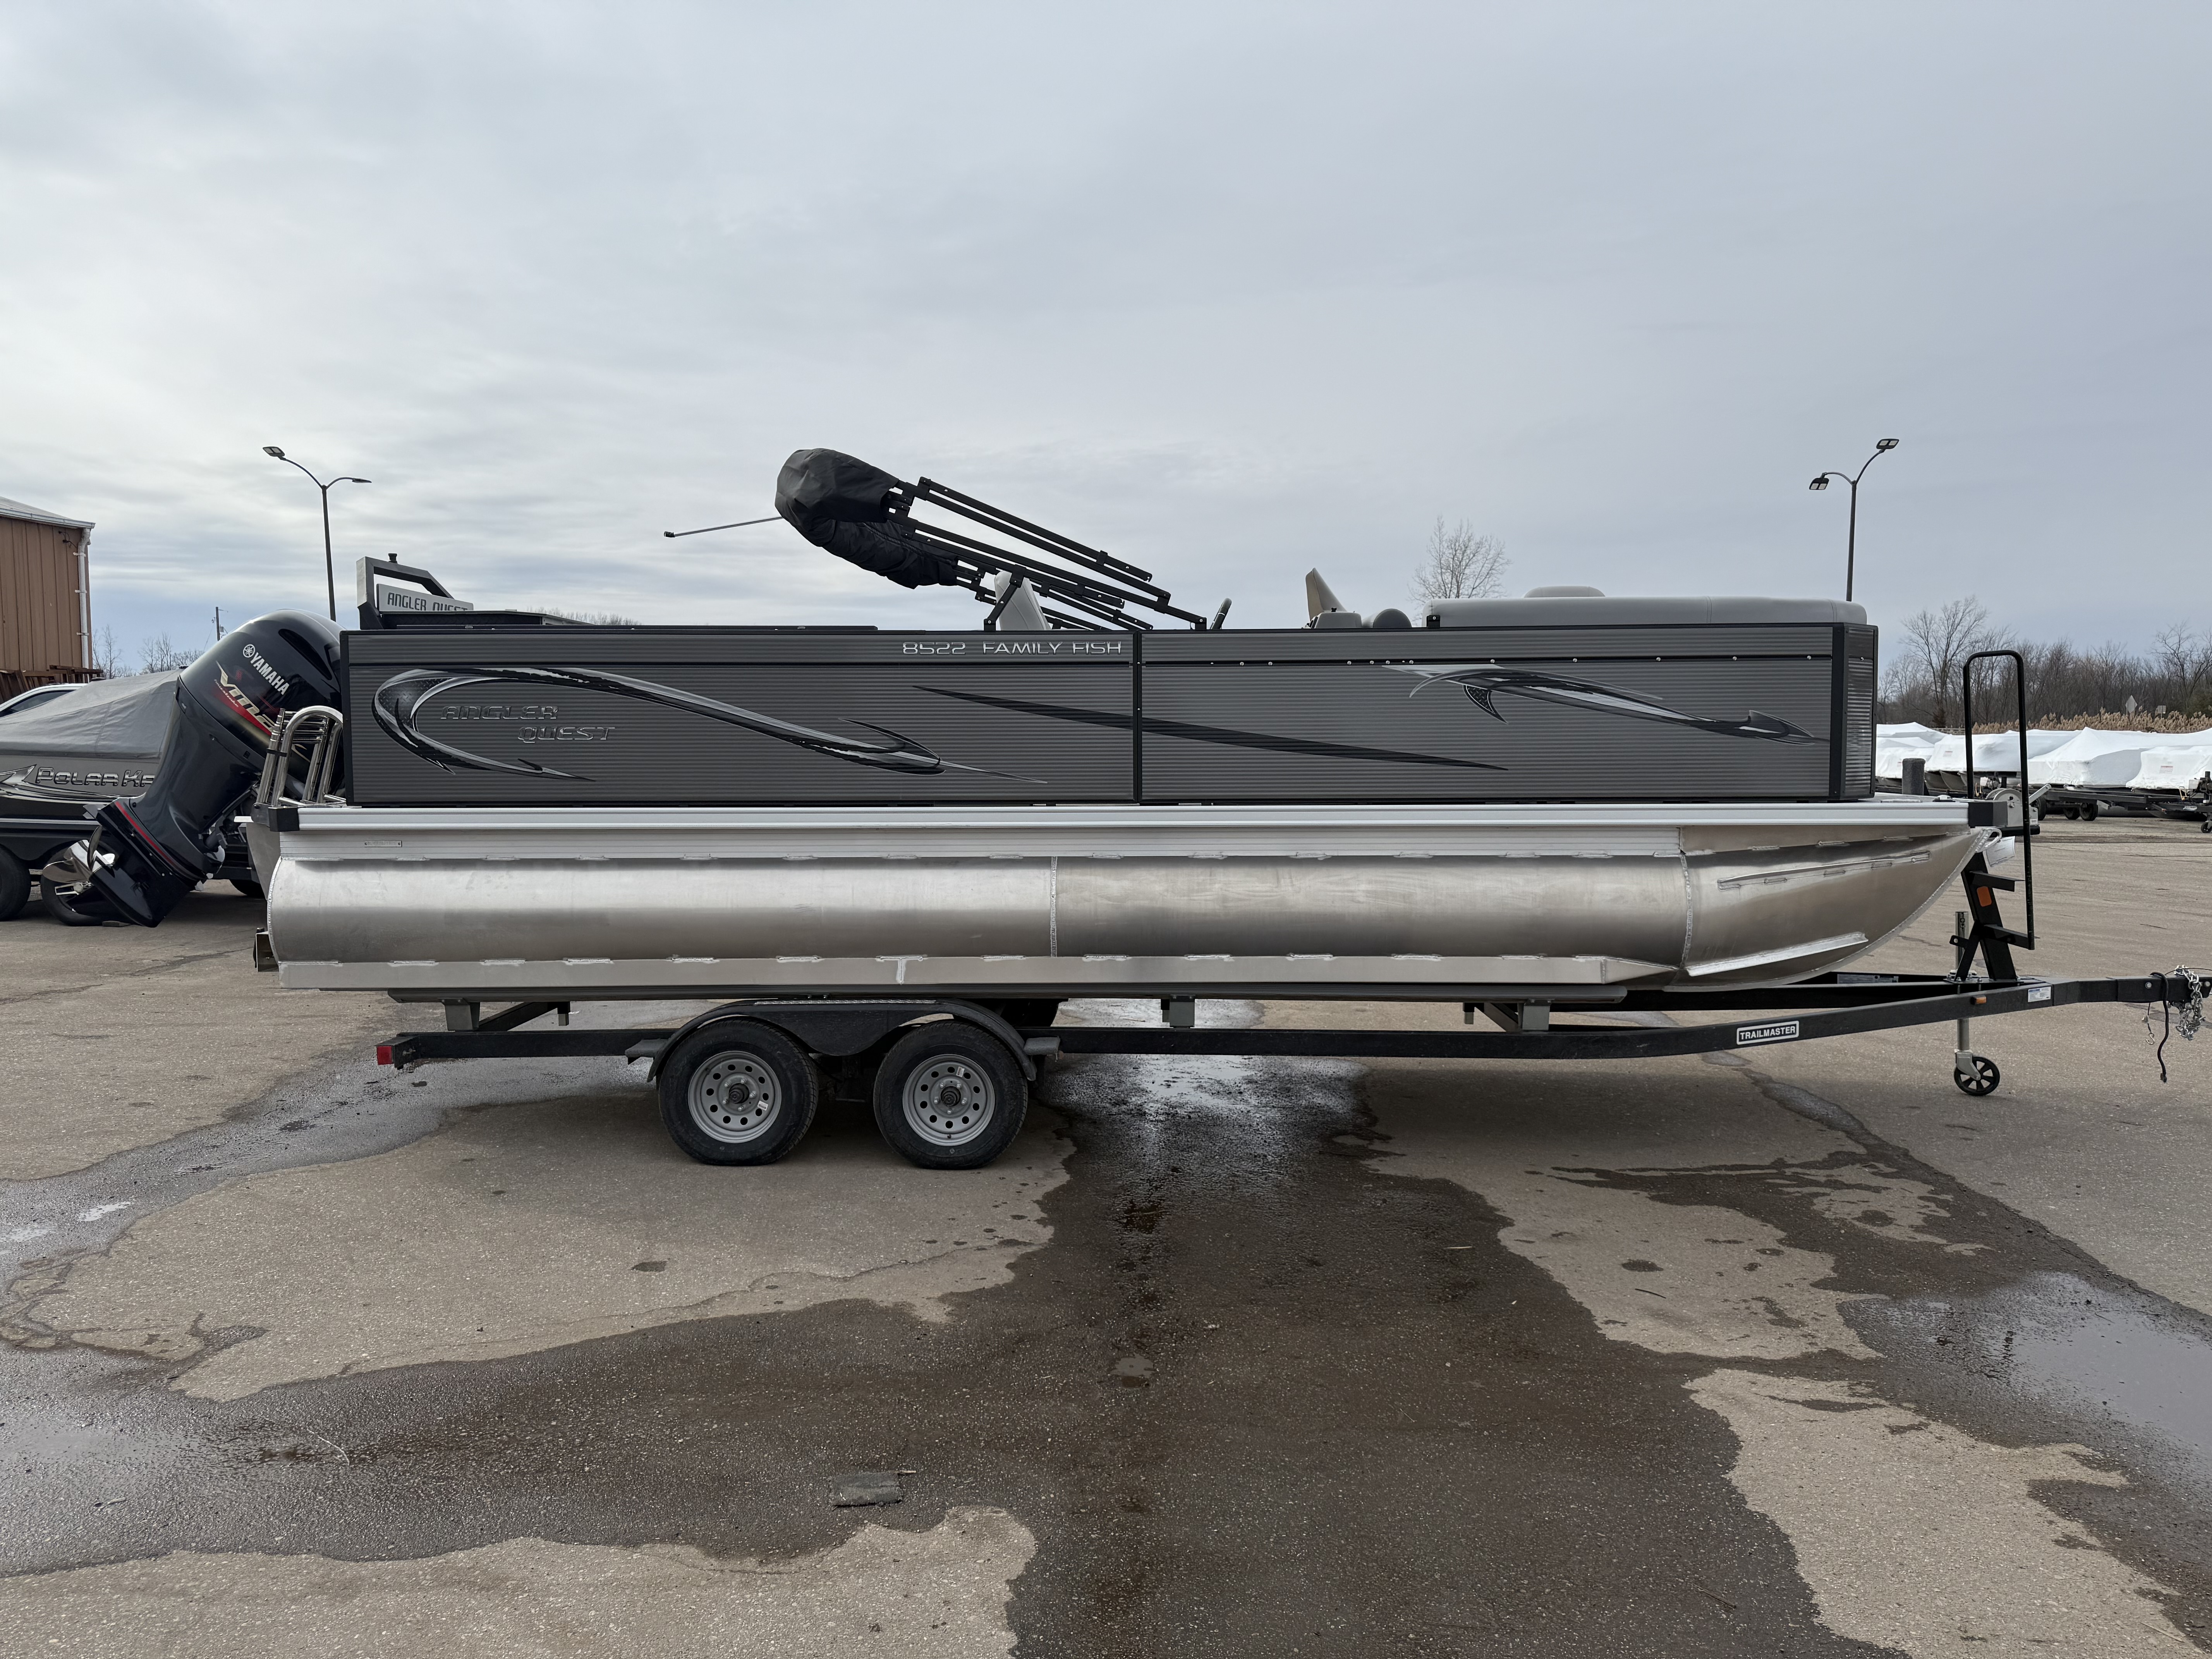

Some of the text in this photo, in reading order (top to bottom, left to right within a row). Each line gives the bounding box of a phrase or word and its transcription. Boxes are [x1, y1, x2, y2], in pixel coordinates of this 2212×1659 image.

[387, 592, 468, 611] ANGLER QUE
[902, 641, 1121, 655] 8522 FAMILY FISH
[250, 652, 290, 695] YAMAHA
[440, 706, 558, 719] ANGLER
[517, 726, 615, 743] QUEST
[35, 767, 119, 786] POLAR
[1740, 1026, 1796, 1040] TRAILMASTER
